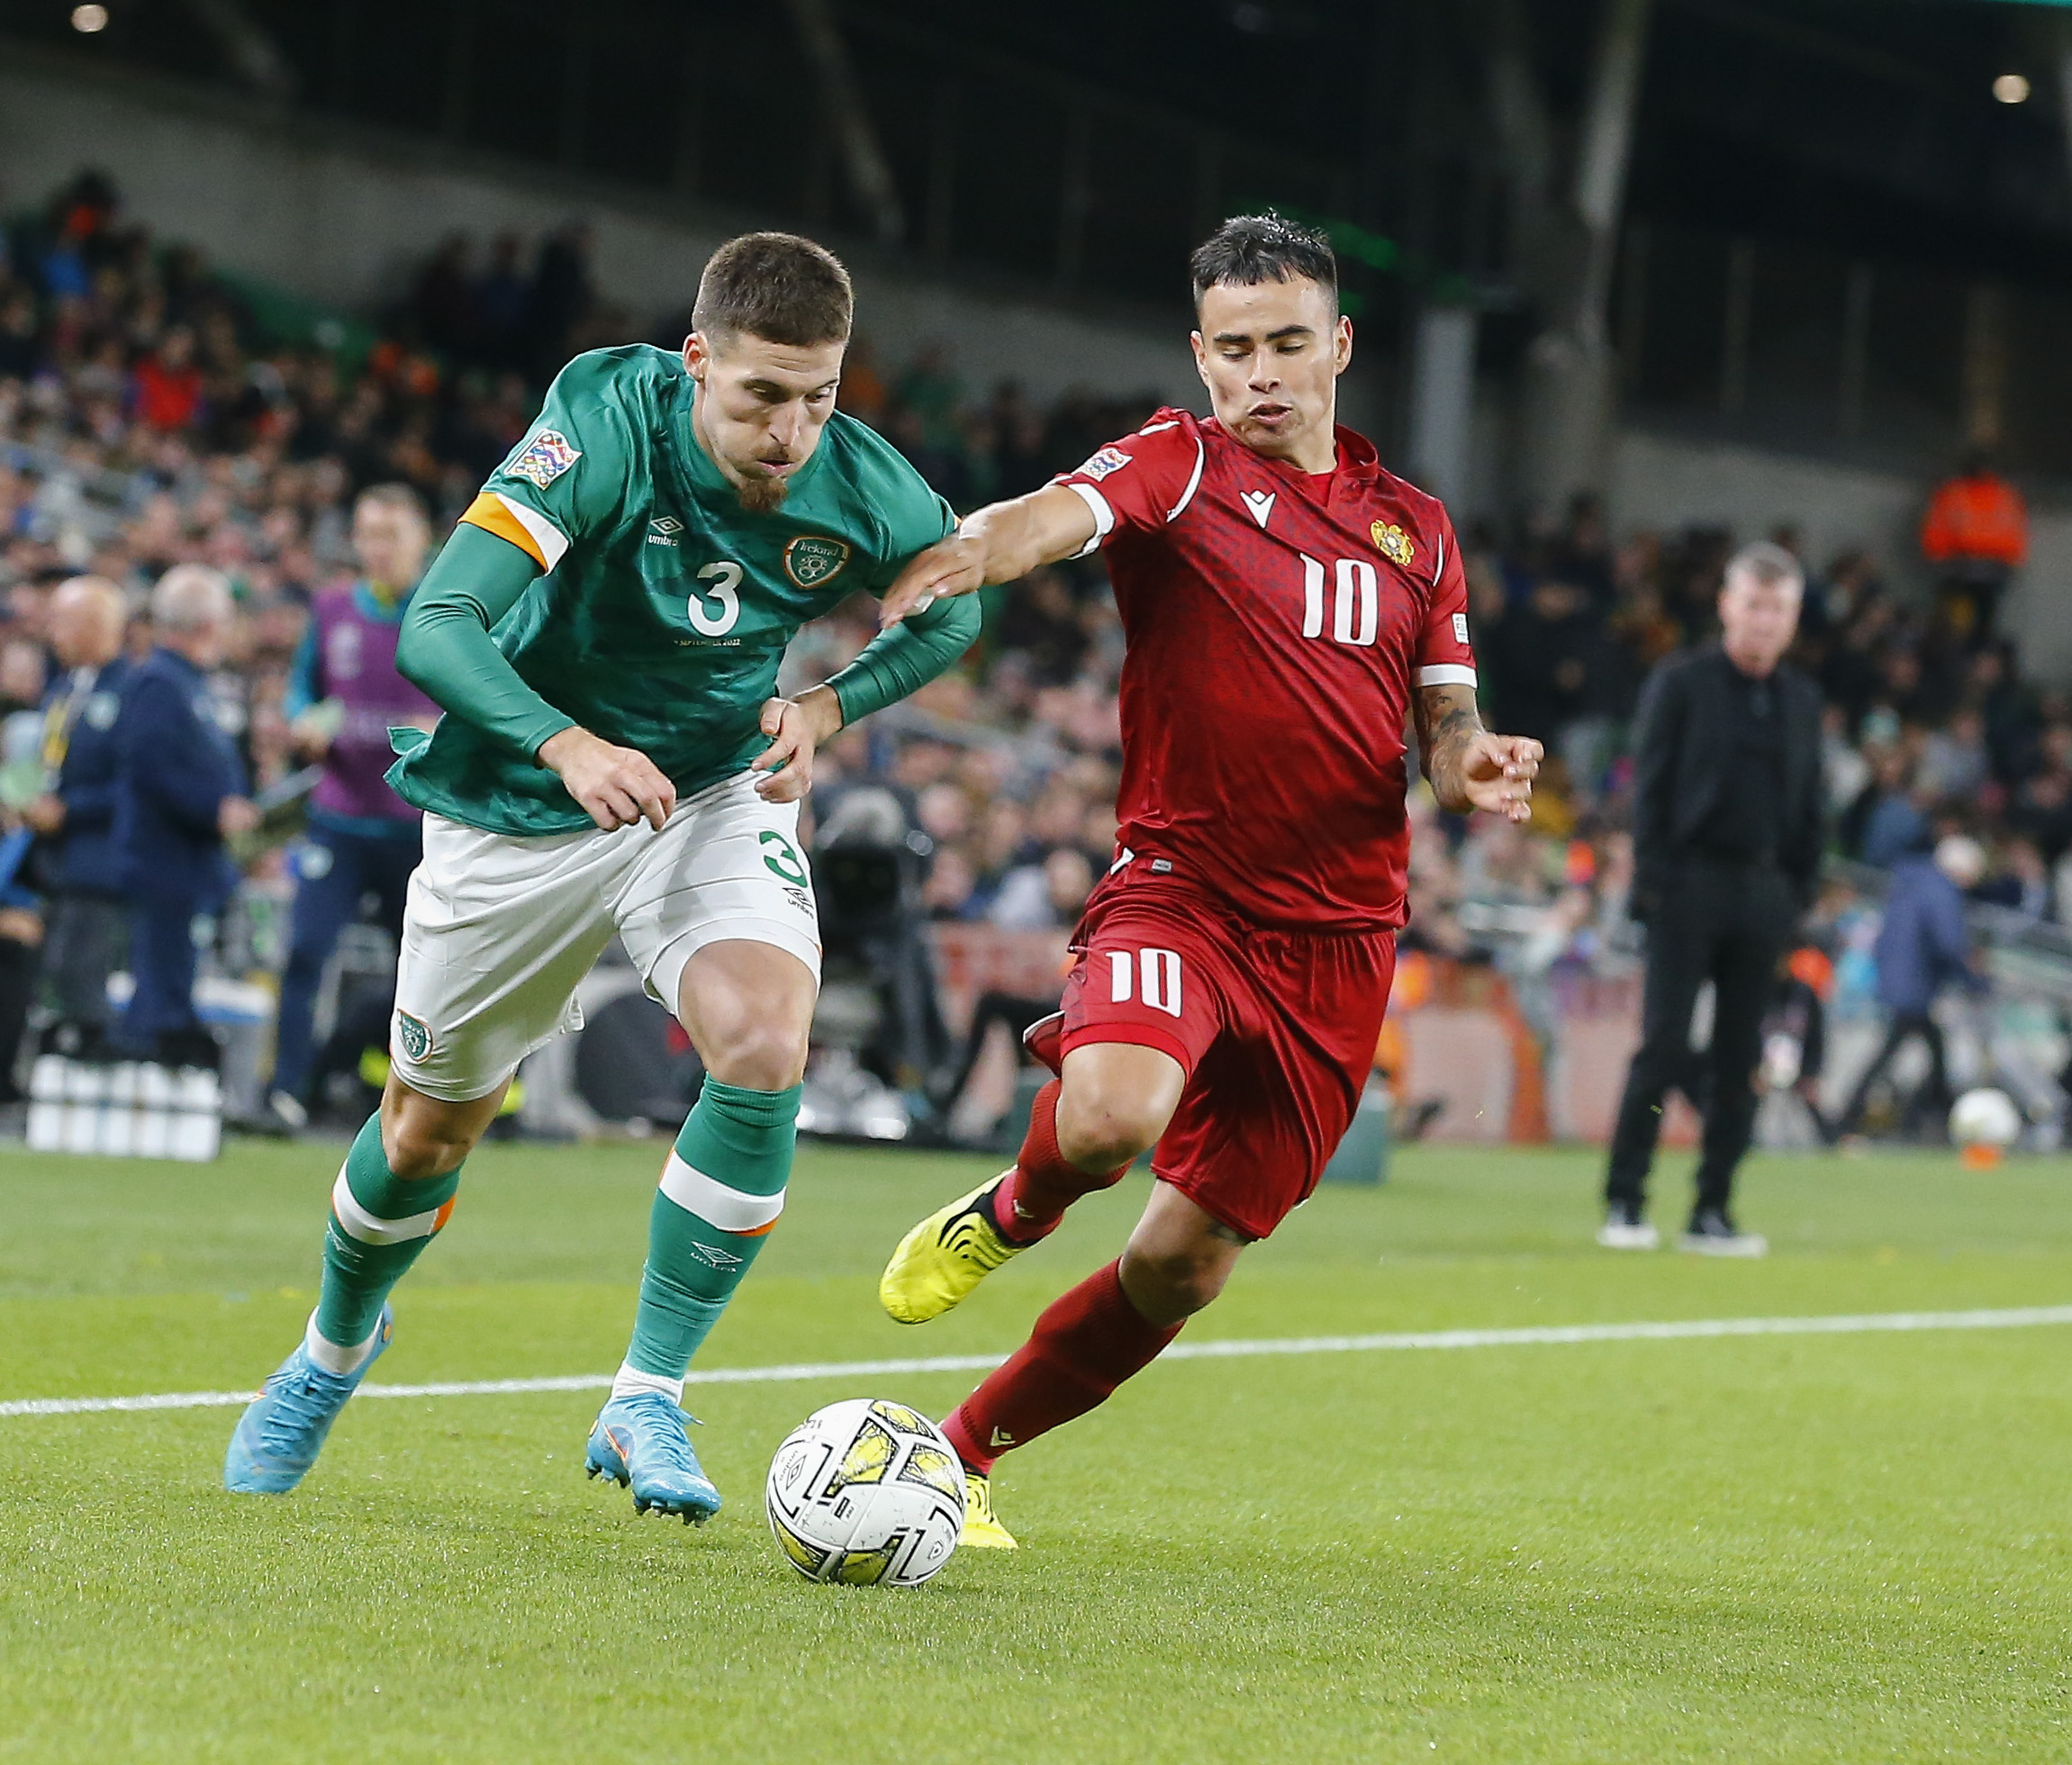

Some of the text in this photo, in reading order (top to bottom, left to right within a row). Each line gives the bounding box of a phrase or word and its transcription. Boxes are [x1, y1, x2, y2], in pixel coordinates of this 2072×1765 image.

[648, 534, 679, 547] umbro
[800, 540, 838, 557] Ireland
[688, 560, 744, 638] 3
[1299, 551, 1379, 647] 10
[758, 829, 809, 889] 3
[1105, 946, 1183, 1019] 10
